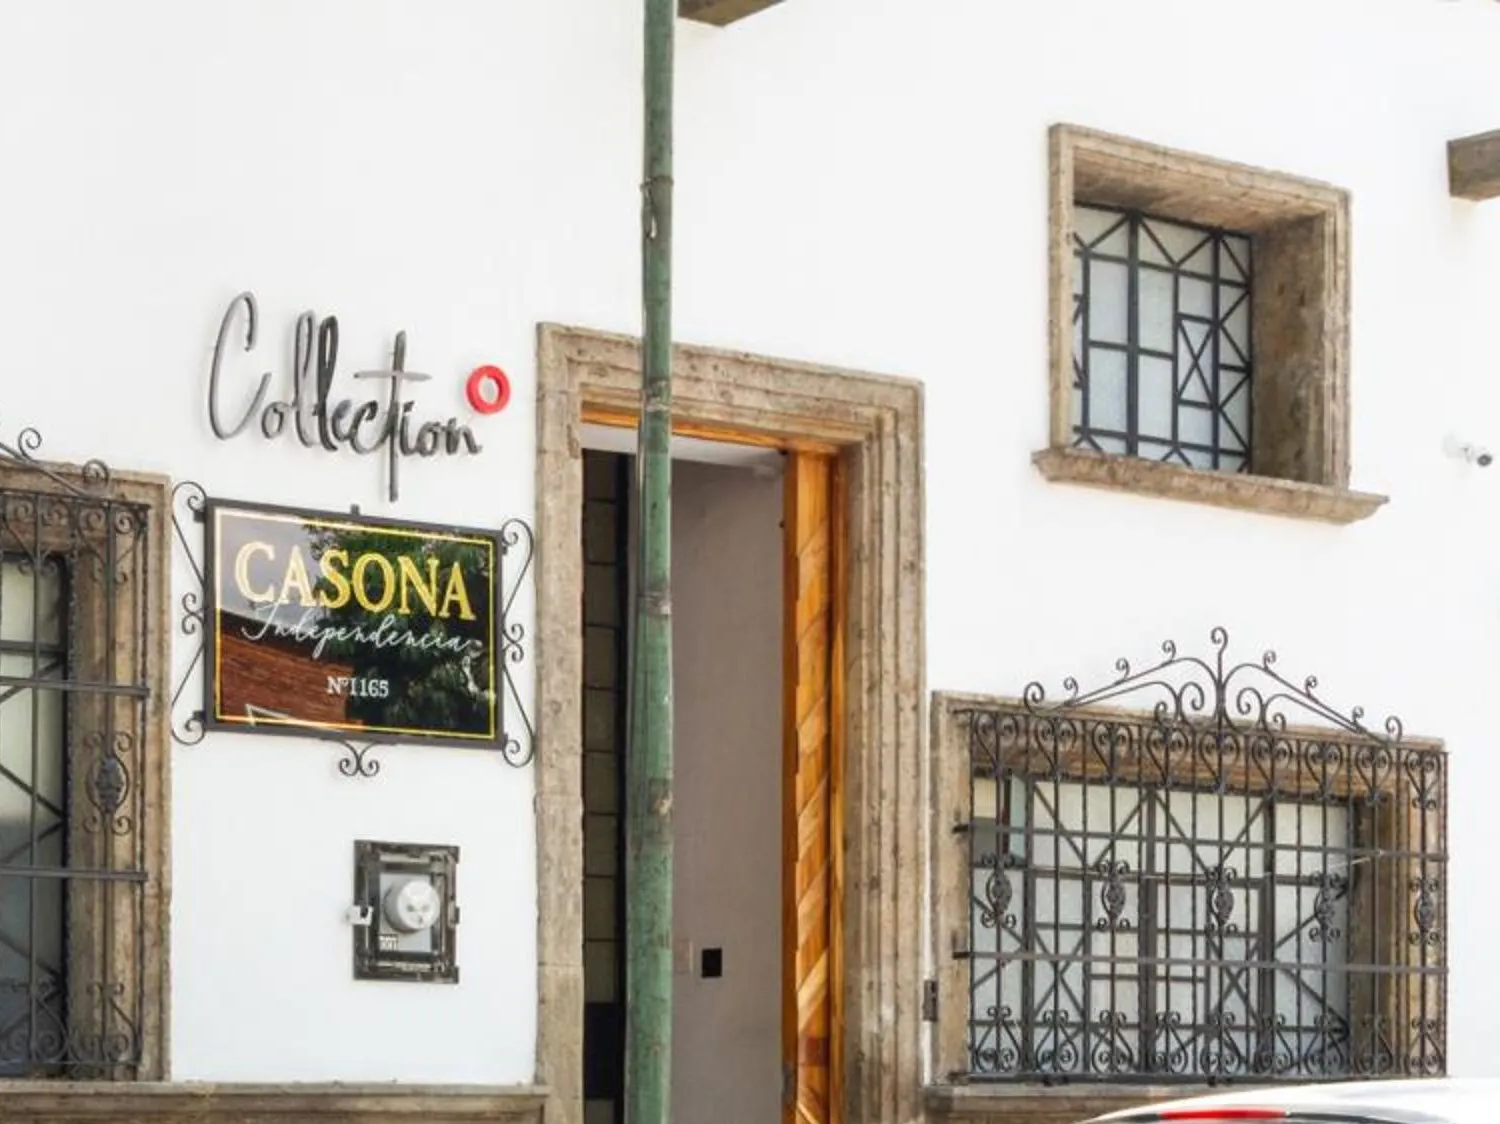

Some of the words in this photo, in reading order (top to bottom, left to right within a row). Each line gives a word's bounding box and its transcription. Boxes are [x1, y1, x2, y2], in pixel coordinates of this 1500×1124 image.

[209, 292, 483, 502] Collection
[234, 541, 477, 621] CASONA
[241, 596, 483, 660] Independencia
